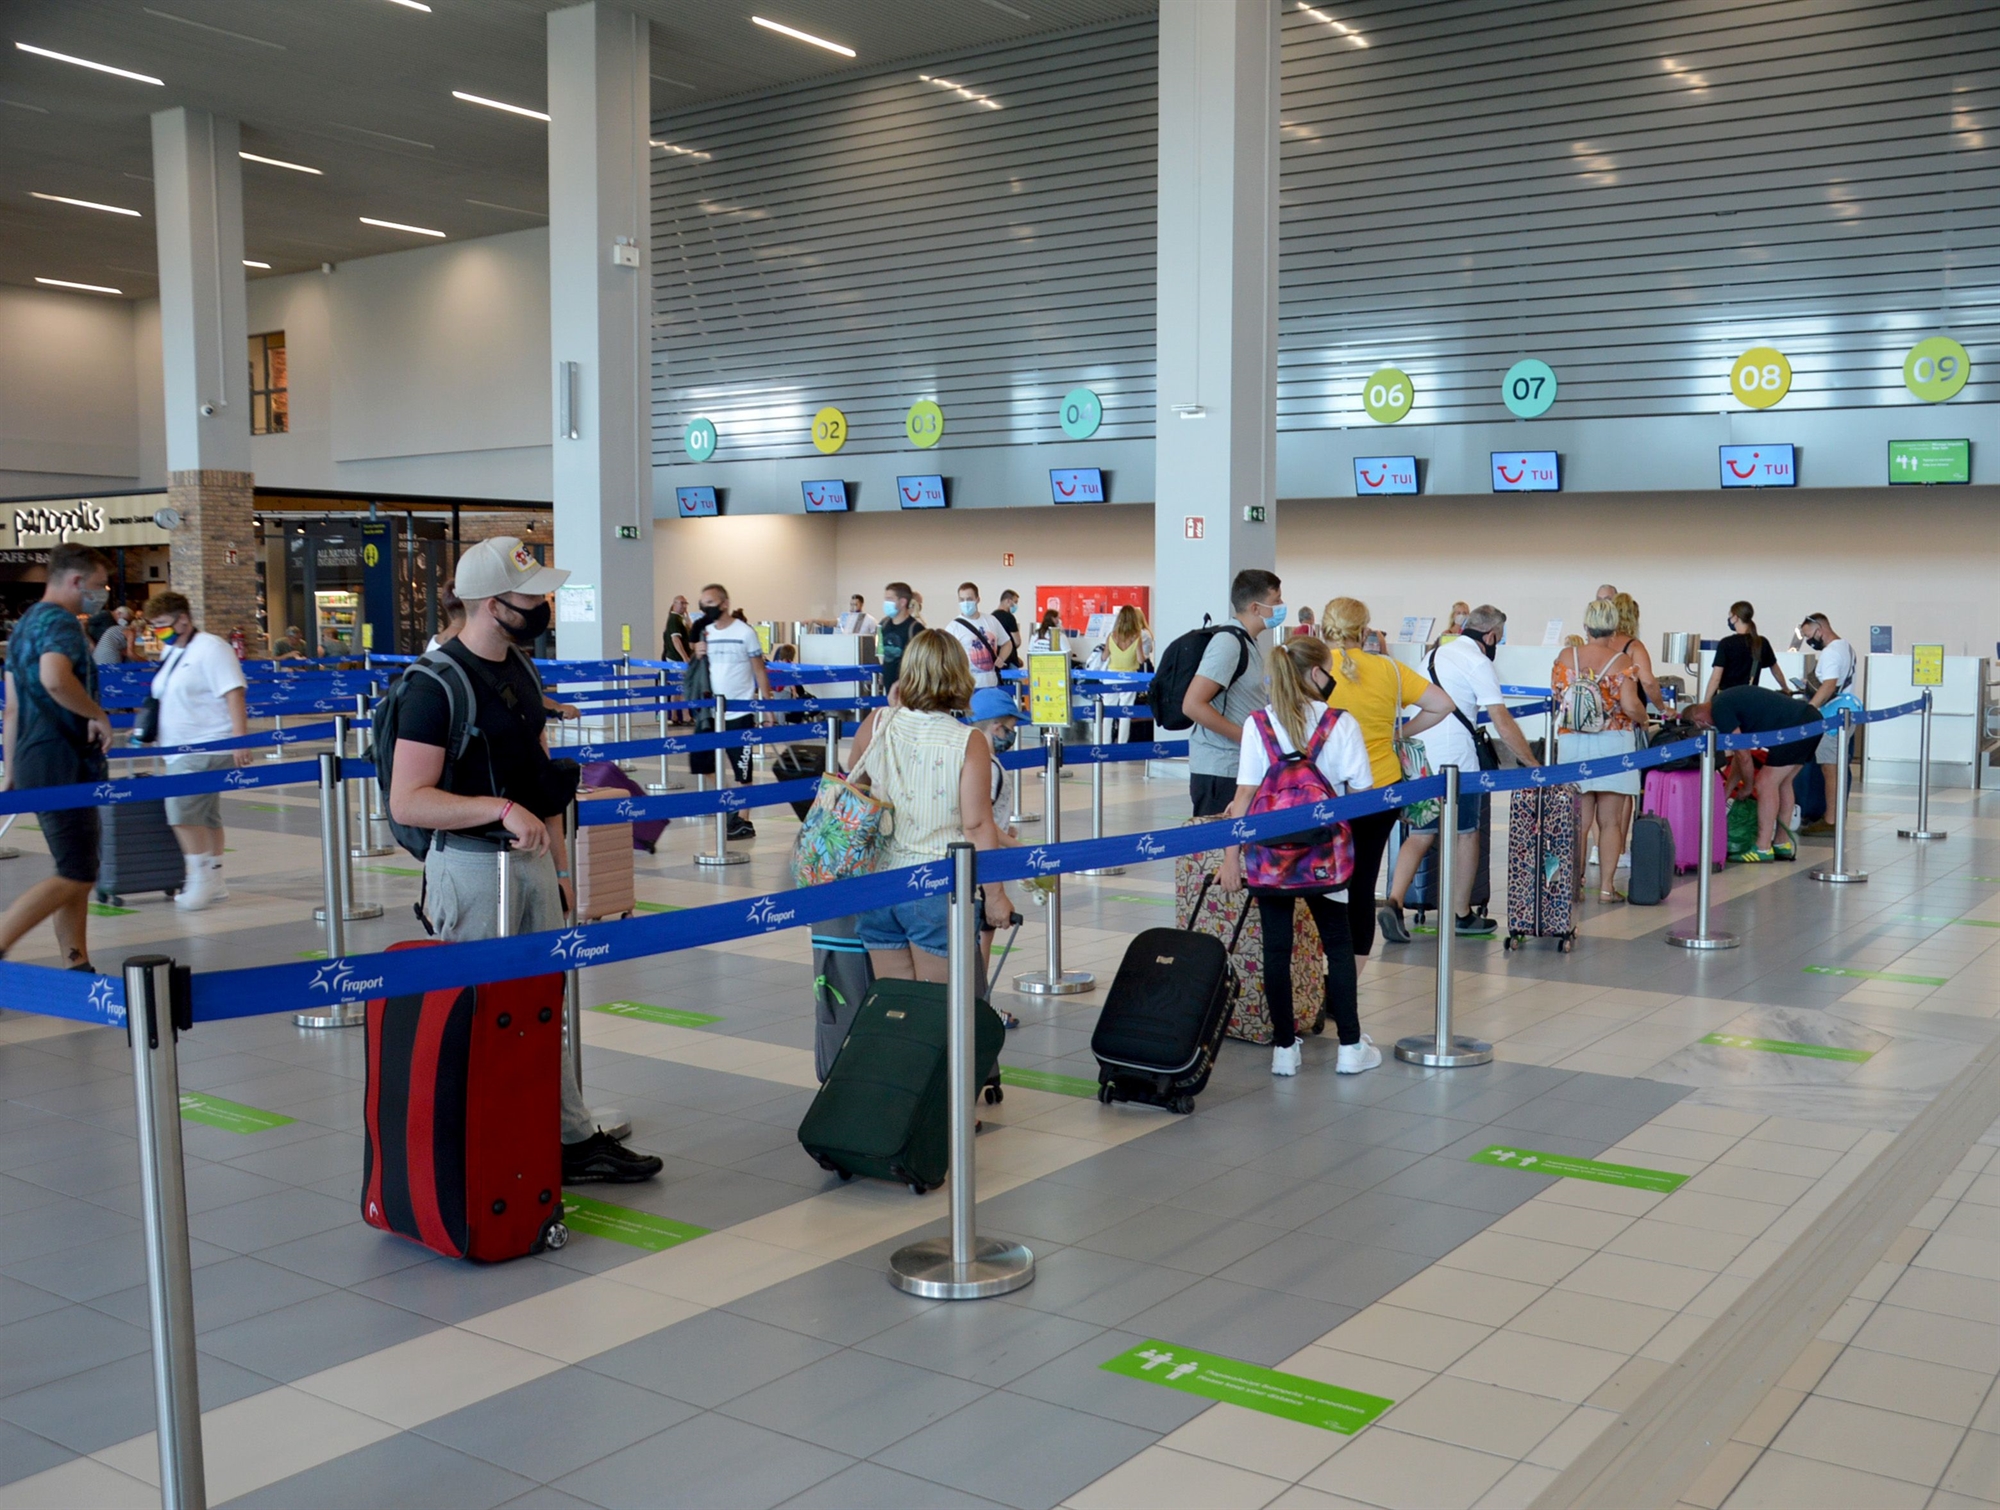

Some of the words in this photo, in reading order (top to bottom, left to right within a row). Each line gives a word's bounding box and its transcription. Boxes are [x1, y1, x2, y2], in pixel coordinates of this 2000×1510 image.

[1738, 364, 1782, 391] 08
[1912, 354, 1960, 384] 09
[1369, 383, 1405, 408] 06
[1512, 376, 1546, 401] 07
[1066, 402, 1094, 425] 04
[816, 421, 841, 441] 02
[911, 413, 937, 434] 03
[690, 430, 709, 450] 01
[1391, 474, 1413, 485] TUI
[1531, 469, 1554, 481] TUI
[1764, 464, 1789, 476] TUI
[828, 494, 844, 504] TUI
[925, 490, 942, 500] TUI
[1081, 484, 1099, 495] TUI
[700, 500, 715, 509] TUI
[737, 745, 752, 780] adida
[767, 909, 795, 924] Fraport
[576, 943, 610, 960] Fraport
[341, 975, 384, 995] Fraport
[107, 1000, 127, 1019] Frap
